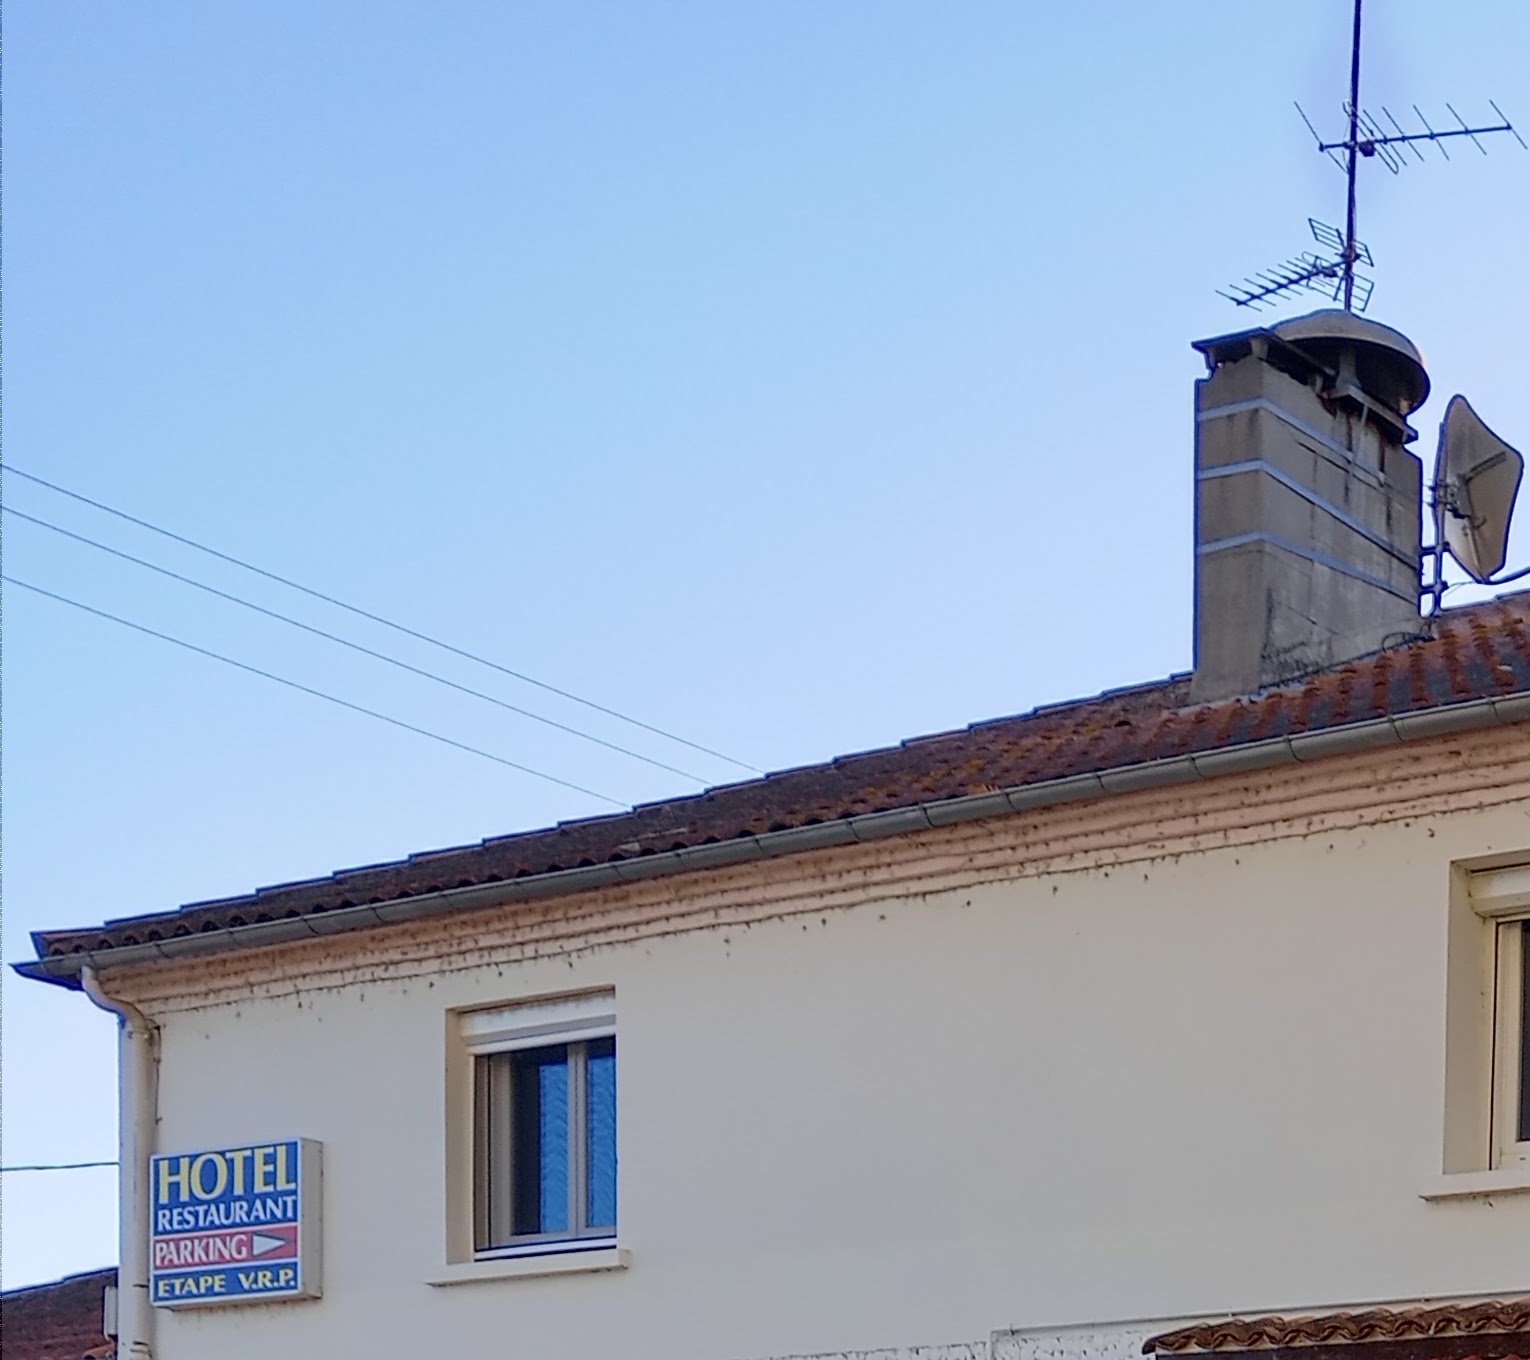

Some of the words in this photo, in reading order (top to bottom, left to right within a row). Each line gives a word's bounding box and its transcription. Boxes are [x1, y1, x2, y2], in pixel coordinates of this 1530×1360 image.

[158, 1144, 297, 1205] HOTEL
[157, 1195, 297, 1233] RESTAURANT
[155, 1233, 248, 1268] PARKING
[157, 1273, 227, 1298] ETAPE
[238, 1267, 296, 1292] V.R.P.
